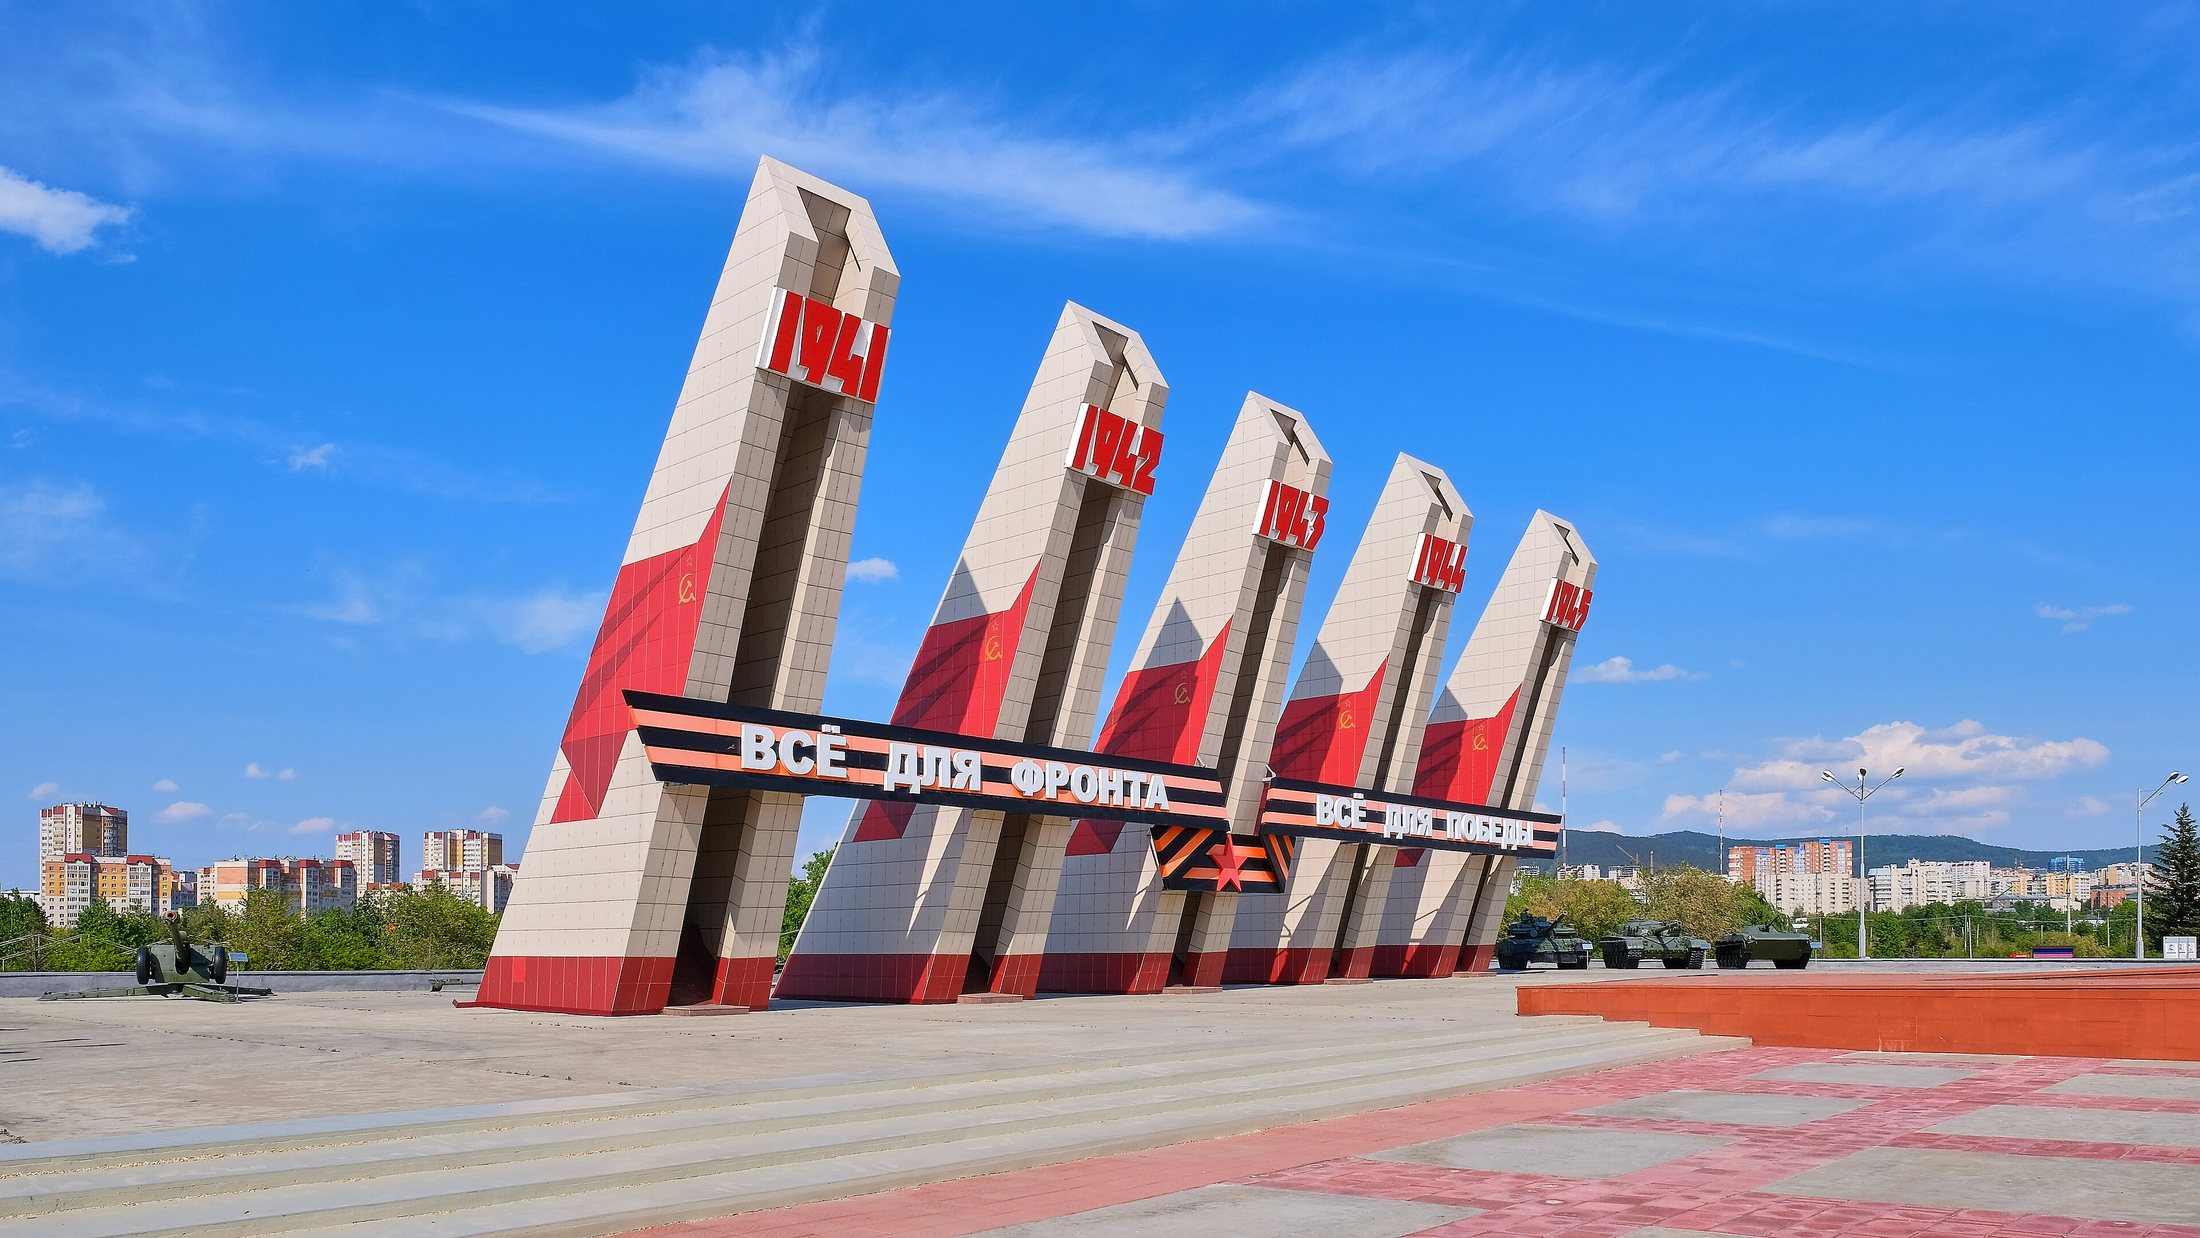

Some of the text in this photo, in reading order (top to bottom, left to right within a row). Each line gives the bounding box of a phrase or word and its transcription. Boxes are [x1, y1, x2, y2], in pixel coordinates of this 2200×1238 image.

[768, 290, 891, 404] 1941
[1072, 403, 1165, 495] 1942
[1258, 479, 1330, 552] 1943
[1413, 533, 1468, 594] 1944
[1545, 578, 1594, 632] 1945
[741, 724, 1170, 810] ВСЁ ДЛЯ ФРОНТА
[1315, 792, 1534, 849] ВСЁ ДЛЯ ПОБЕДЫ
